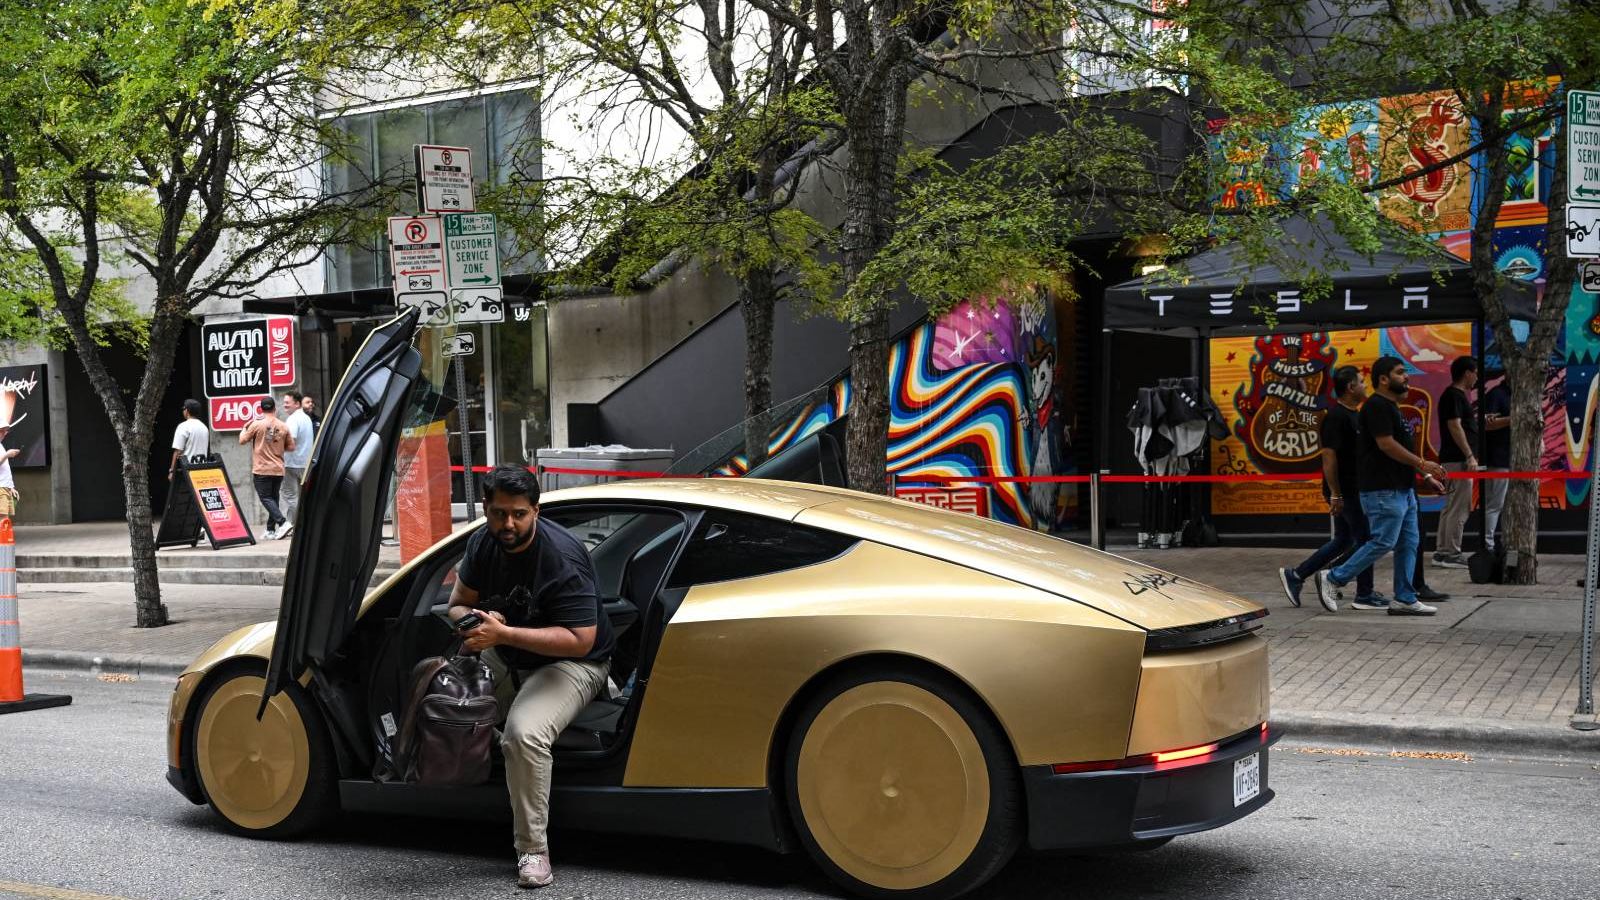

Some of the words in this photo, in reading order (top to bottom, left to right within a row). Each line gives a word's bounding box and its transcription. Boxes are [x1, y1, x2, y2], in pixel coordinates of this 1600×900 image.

[1572, 94, 1583, 113] 15
[1572, 113, 1583, 124] MIN
[448, 215, 458, 228] 15
[450, 238, 492, 250] CUSTOMER
[456, 250, 488, 262] SERVICE
[464, 264, 484, 274] ZONE
[1150, 286, 1429, 316] TESLA
[208, 329, 264, 350] AUSTIN
[1282, 336, 1301, 346] LIVE
[218, 349, 253, 368] CITY
[272, 327, 290, 376] LIVE
[1274, 361, 1314, 374] MUSIC
[1266, 383, 1318, 408] CAPITAL
[1268, 410, 1282, 424] OF
[1299, 411, 1318, 425] THE
[1263, 428, 1318, 456] WORLD
